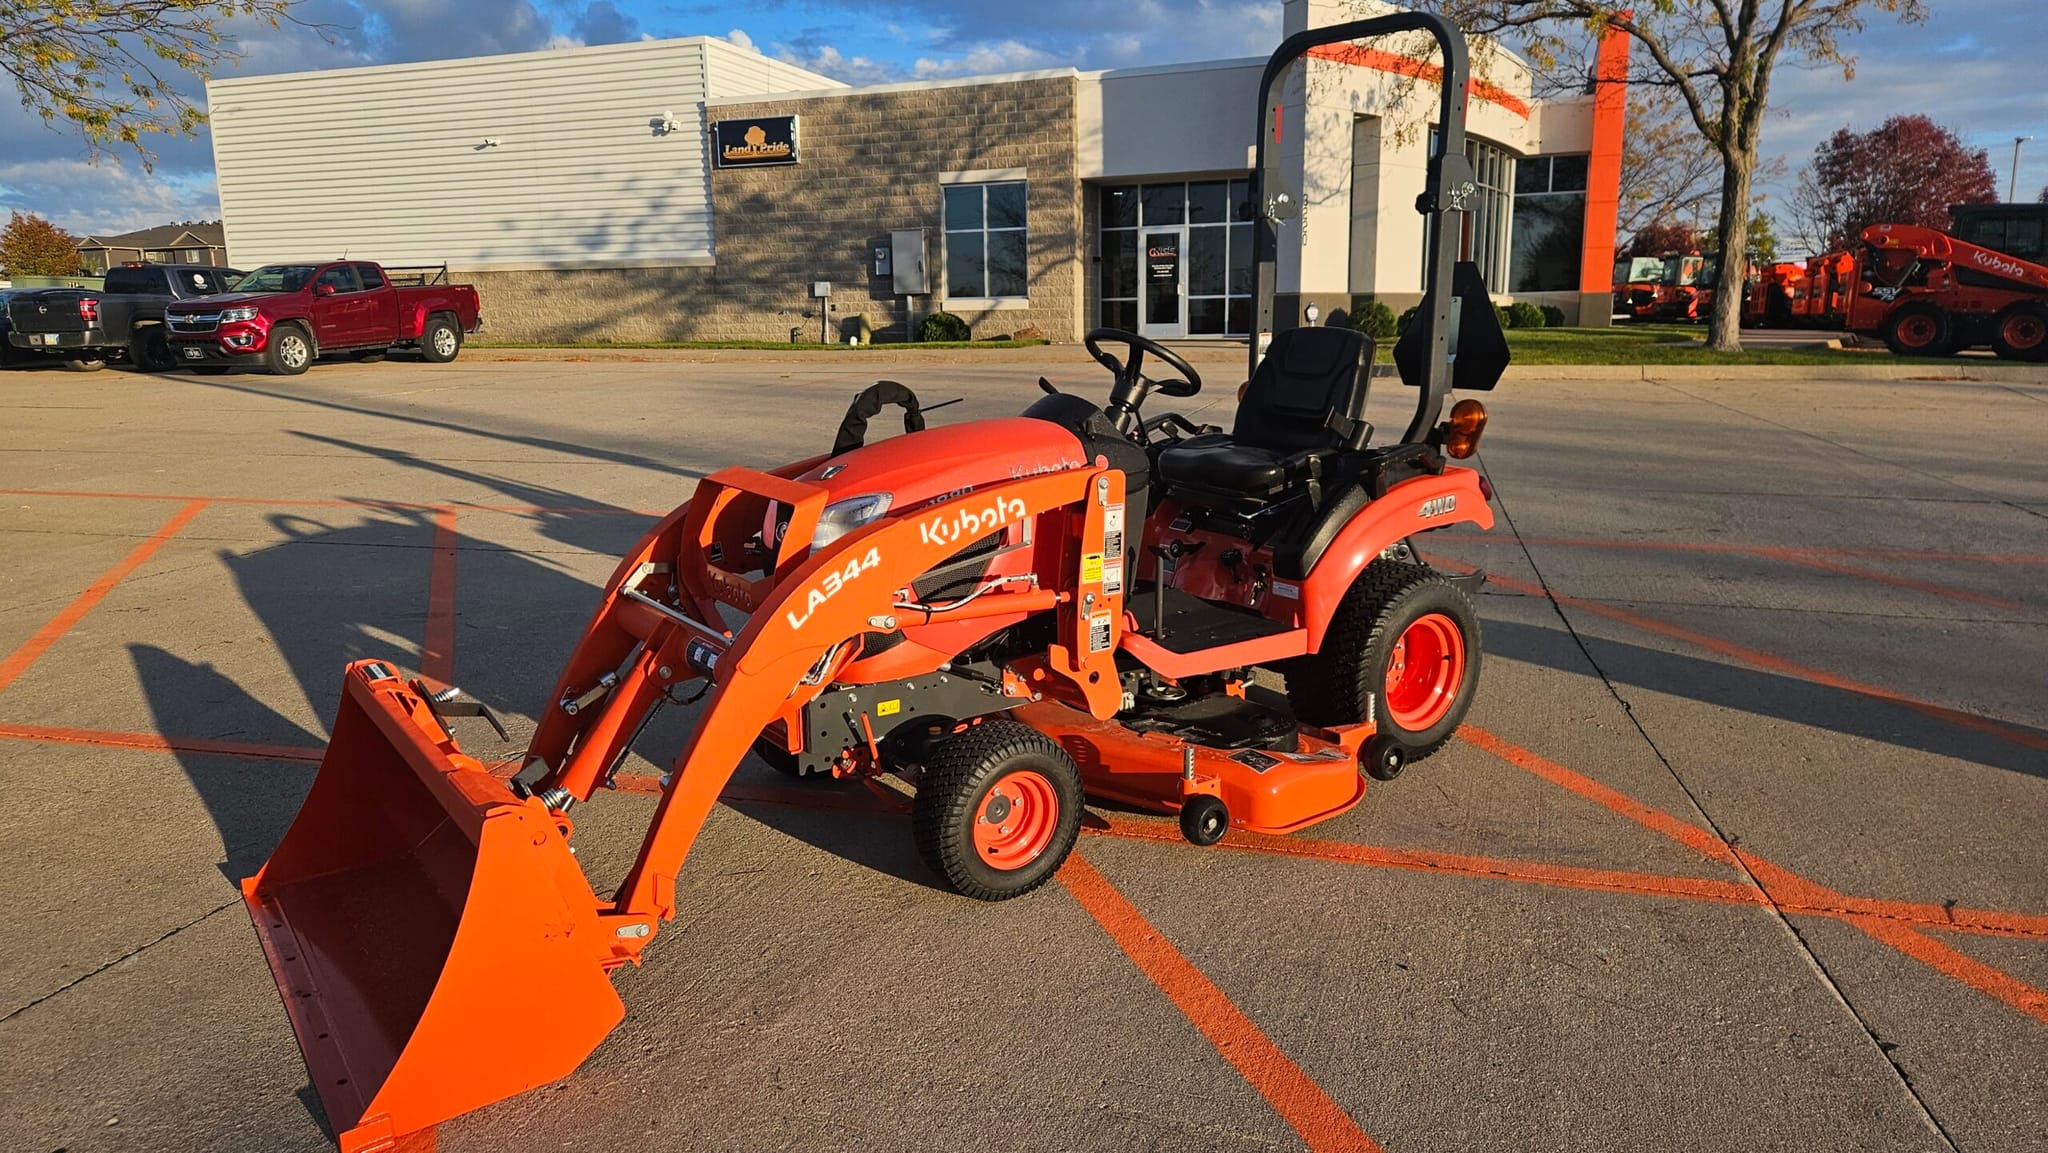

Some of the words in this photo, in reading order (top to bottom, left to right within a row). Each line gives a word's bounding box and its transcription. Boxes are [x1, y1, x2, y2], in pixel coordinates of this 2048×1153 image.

[725, 144, 751, 153] Land
[759, 141, 790, 153] Pride
[1973, 250, 2024, 277] Kubota
[1417, 494, 1457, 519] 4WD
[919, 496, 1027, 546] Kubota
[786, 547, 882, 631] LA344
